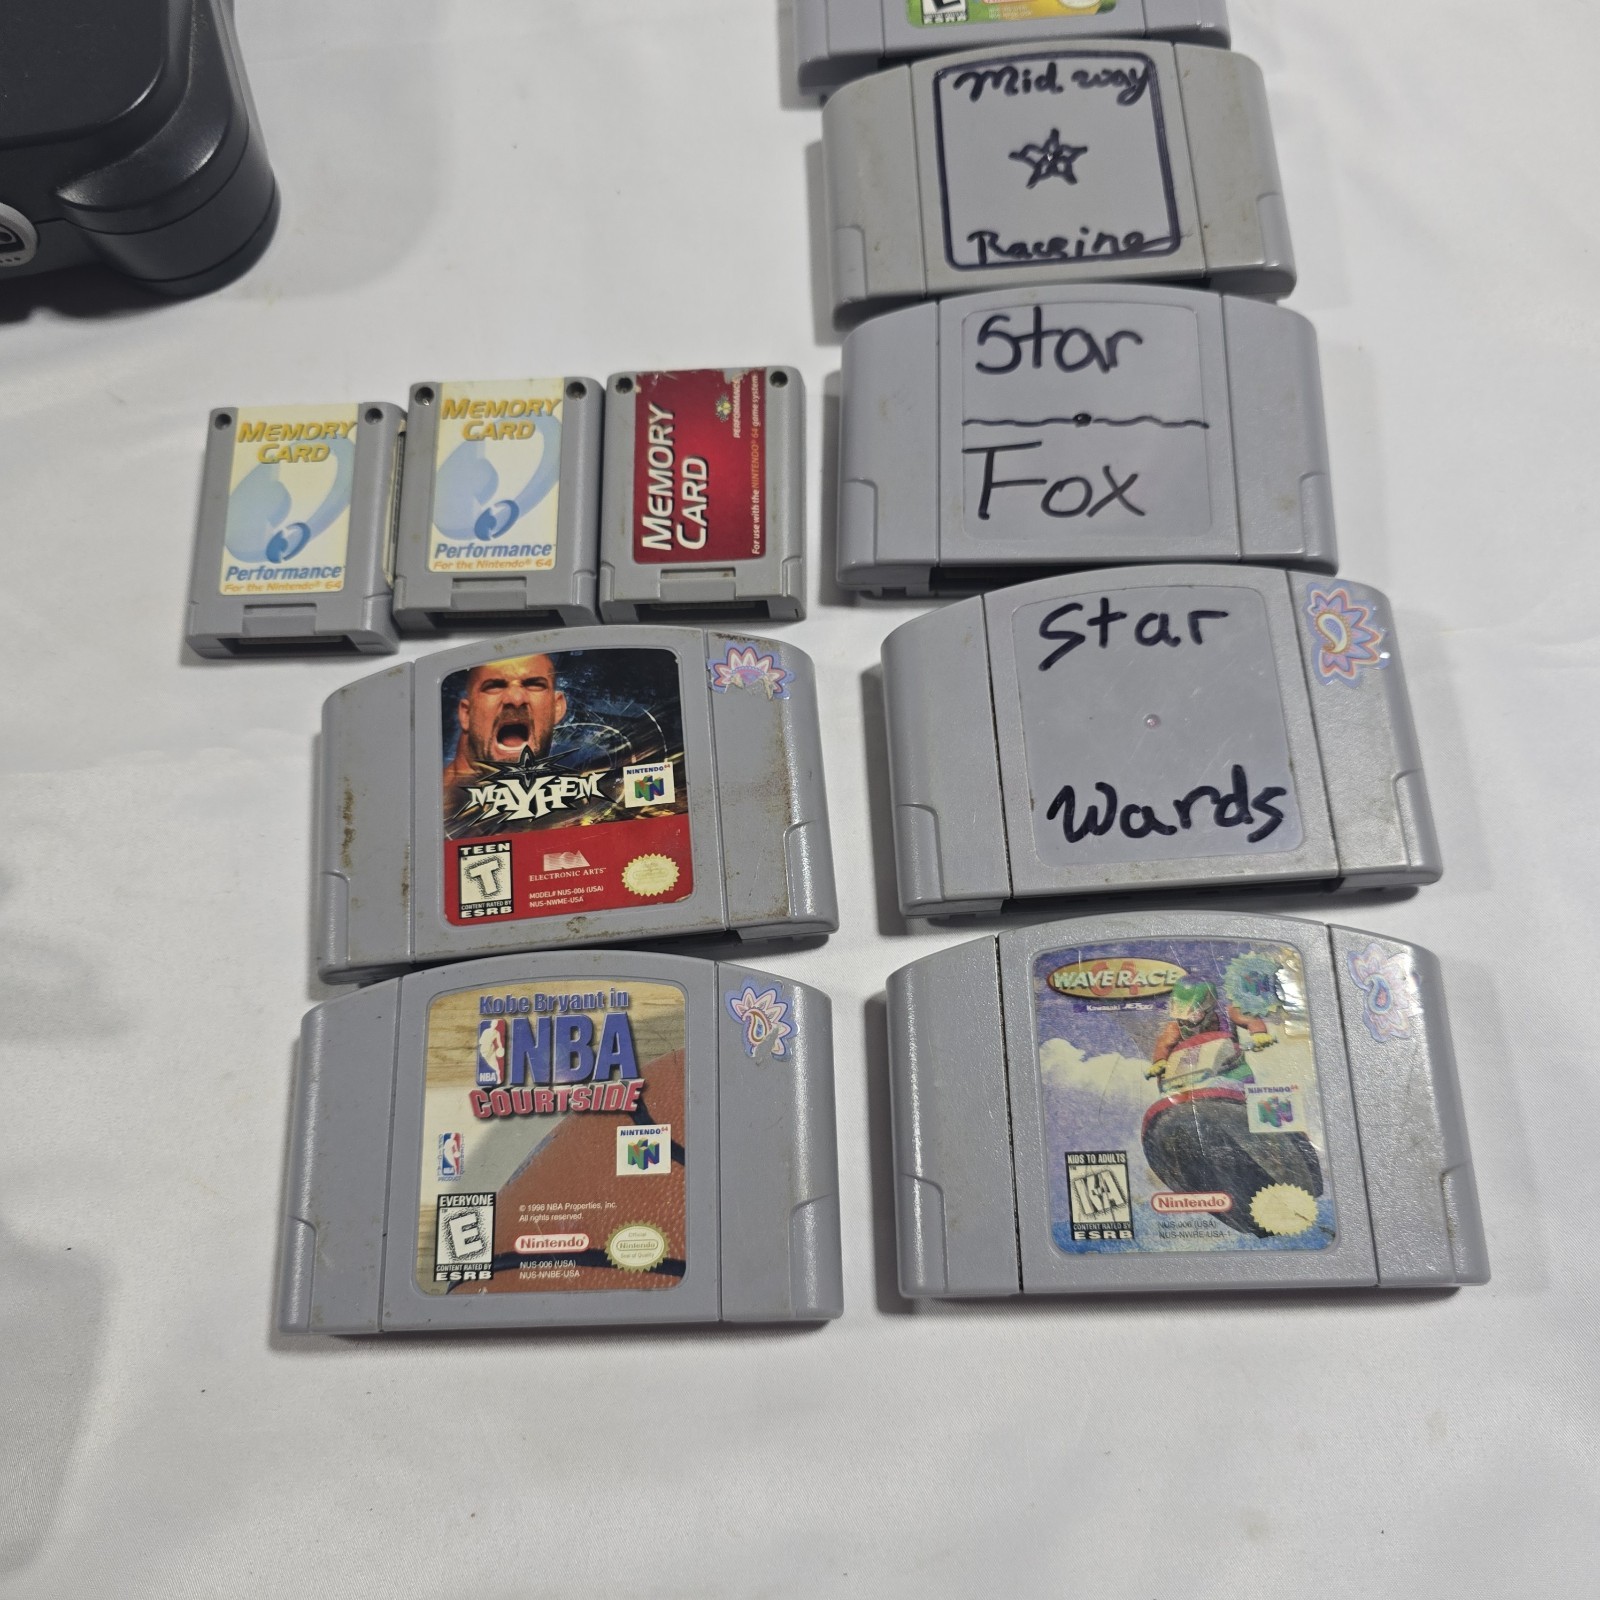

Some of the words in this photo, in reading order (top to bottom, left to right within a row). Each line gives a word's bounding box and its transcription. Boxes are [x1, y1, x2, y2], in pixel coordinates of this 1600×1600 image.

[976, 305, 1143, 375] Star
[441, 399, 562, 420] MEMORY
[752, 403, 761, 427] game
[237, 421, 357, 442] MEMORY
[462, 420, 535, 441] CARD
[751, 428, 759, 438] 64
[257, 444, 330, 464] CARD
[642, 401, 675, 550] MEMORY
[961, 441, 1145, 520] Fox
[676, 456, 709, 550] CARD
[751, 489, 760, 503] the
[751, 504, 760, 523] with
[434, 543, 553, 558] Performance
[752, 540, 760, 555] For
[433, 562, 453, 570] For
[456, 560, 472, 569] the
[535, 558, 552, 567] 64
[225, 565, 342, 581] Performance
[325, 580, 341, 589] 64
[1039, 597, 1228, 671] Star
[626, 766, 664, 775] NINTENDO
[467, 772, 608, 822] MAYHEM
[1046, 764, 1286, 843] Wards
[460, 842, 511, 855] TEEN
[529, 870, 580, 882] ELECTRONIC
[529, 890, 556, 899] MODEL#
[557, 887, 585, 896] NUS-006
[586, 885, 604, 893] (USA)
[529, 896, 584, 908] NUS-NWME-USA
[461, 906, 512, 918] ESRB
[1052, 970, 1115, 989] WAVE
[1116, 969, 1180, 988] RACE
[479, 995, 529, 1015] Kobe
[533, 991, 605, 1013] Bryant
[609, 988, 629, 1009] in
[510, 1011, 639, 1085] NBA
[479, 1072, 497, 1082] NBA
[469, 1078, 645, 1119] COURTSIDE
[620, 1128, 661, 1137] NINTENDO
[1067, 1154, 1085, 1164] KIDS
[1086, 1153, 1096, 1163] TO
[1098, 1152, 1126, 1163] ADULTS
[440, 1194, 494, 1207] EVERYONE
[565, 1201, 603, 1212] Properties,
[519, 1214, 528, 1222] All
[530, 1213, 549, 1223] rights
[551, 1212, 584, 1220] reserved.
[1074, 1230, 1132, 1239] ESRB
[436, 1264, 462, 1272] CONTENT
[463, 1263, 482, 1271] RATED
[520, 1260, 552, 1269] NUS-006
[555, 1259, 576, 1268] (USA)
[436, 1270, 492, 1281] ESRB
